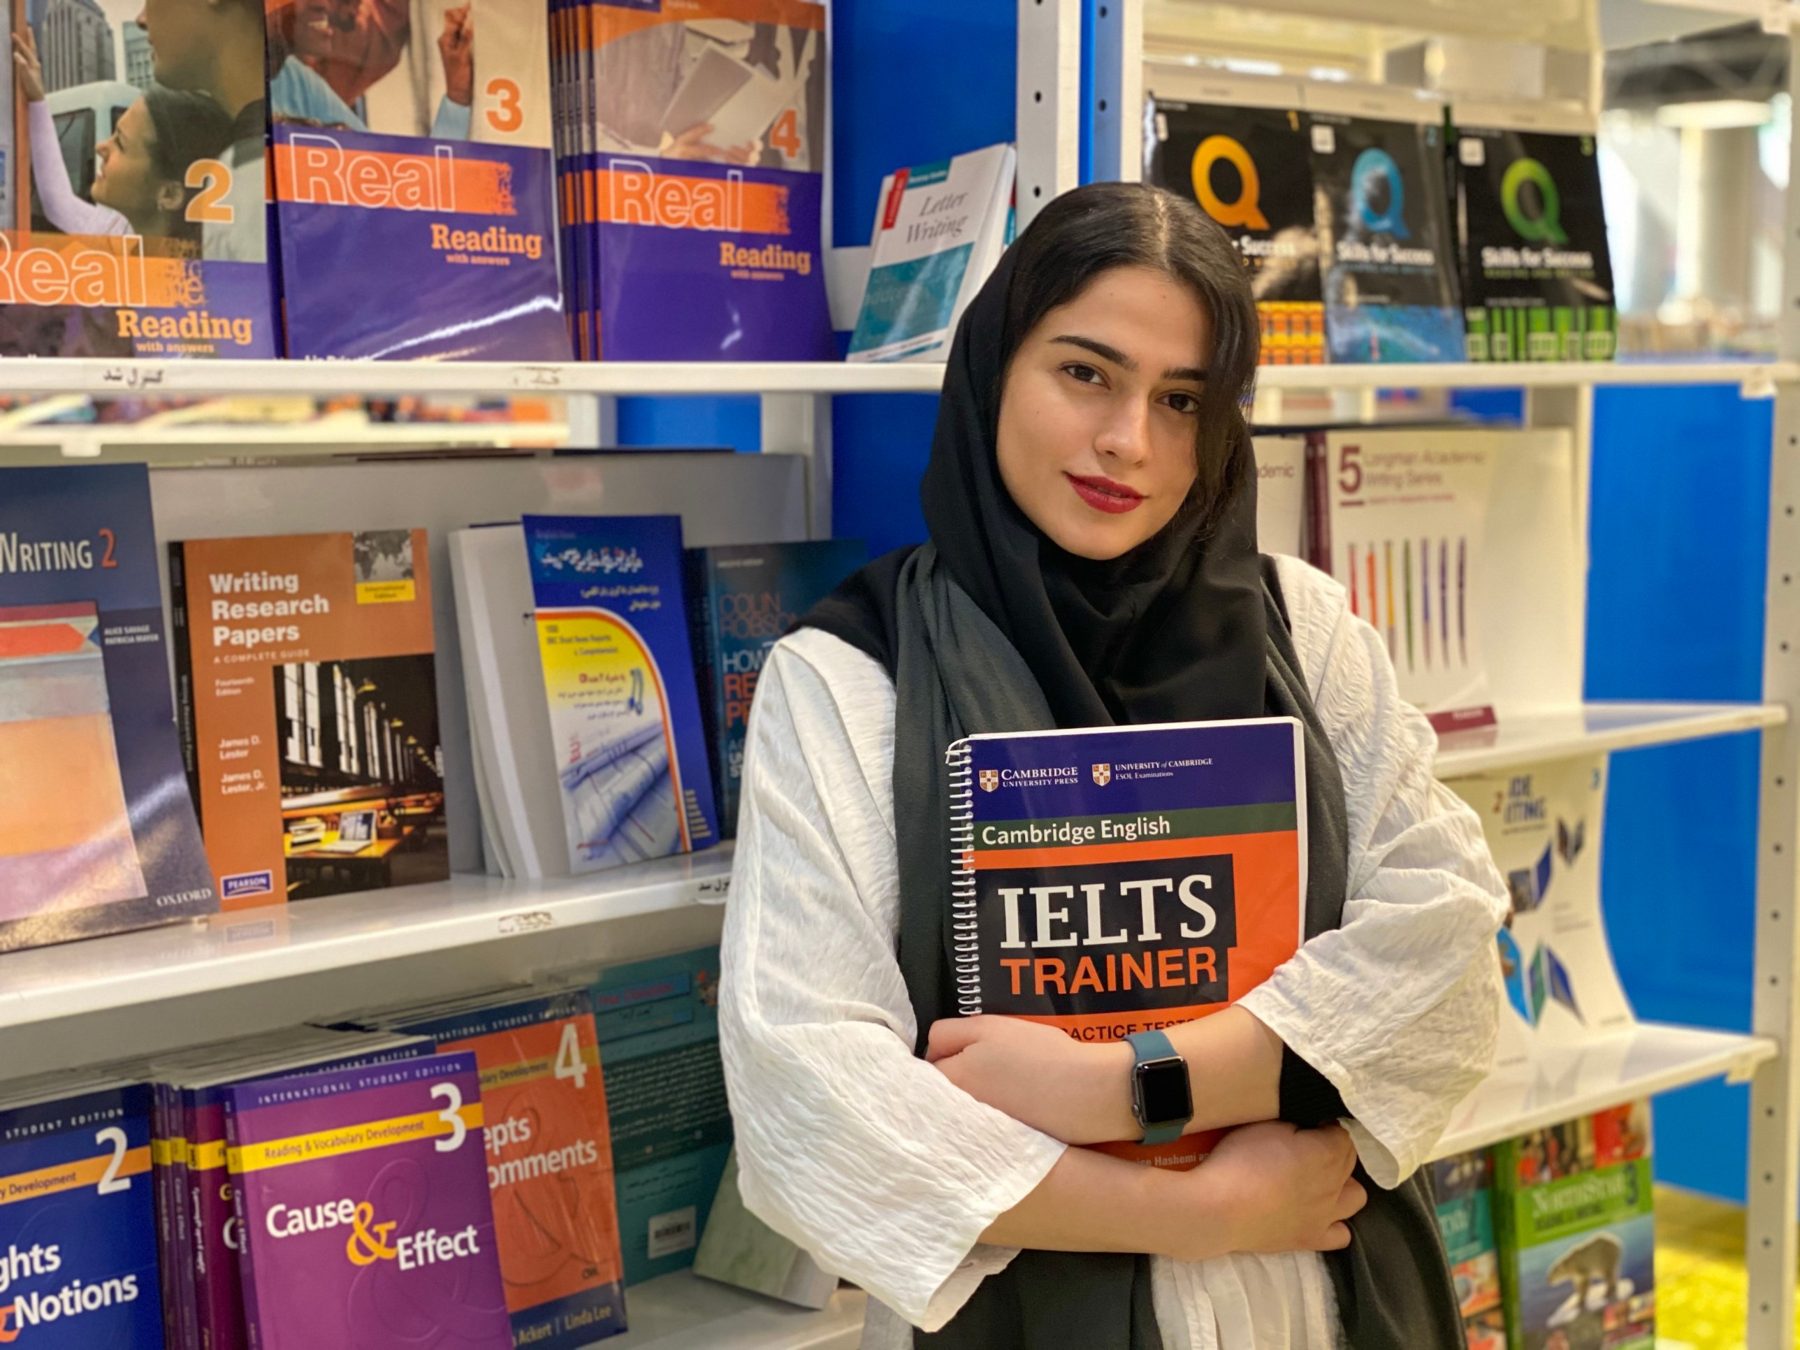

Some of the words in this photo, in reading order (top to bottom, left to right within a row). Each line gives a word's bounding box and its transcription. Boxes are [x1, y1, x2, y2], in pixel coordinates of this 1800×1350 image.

[485, 78, 523, 132] 3
[769, 108, 801, 159] 4
[290, 133, 455, 212] Real
[1191, 134, 1271, 231] Q
[185, 159, 234, 223] 2
[609, 159, 743, 231] Real
[919, 192, 969, 217] Letter
[1352, 147, 1411, 240] Q
[1502, 157, 1569, 243] Q
[430, 224, 542, 259] Reading
[906, 215, 968, 243] Writing
[719, 242, 811, 275] Reading
[116, 309, 252, 344] Reading
[1339, 444, 1362, 494] 5
[99, 528, 118, 568] 2
[209, 571, 299, 593] Writing
[211, 594, 330, 620] Research
[213, 626, 300, 648] Papers
[213, 656, 221, 664] A
[1001, 766, 1079, 780] CAMBRIDGE
[1115, 761, 1160, 771] UNIVERSITY
[1168, 757, 1214, 768] CAMBRIDGE
[1115, 771, 1133, 780] ESOL
[1135, 769, 1174, 779] Examinations
[1002, 779, 1052, 787] UNIVERSITY
[1054, 777, 1079, 785] PRESS
[982, 821, 1096, 846] Cambridge
[1101, 816, 1171, 842] English
[157, 889, 213, 908] OXFORD
[227, 876, 268, 891] PEARSON
[998, 874, 1217, 949] IELTS
[1000, 945, 1218, 995] TRAINER
[554, 1023, 588, 1089] 4
[257, 1083, 352, 1105] INTERNATIONAL
[359, 1070, 408, 1087] STUDENT
[415, 1062, 462, 1078] EDITION
[5, 1120, 62, 1140] STUDENT
[71, 1106, 125, 1126] EDITION
[366, 1120, 426, 1141] Development
[430, 1082, 467, 1153] 3
[95, 1126, 132, 1195] 2
[1154, 1152, 1197, 1166] Hashemi
[9, 1172, 76, 1195] Development
[266, 1197, 357, 1238] Cause
[346, 1201, 397, 1266] &
[397, 1224, 480, 1271] Effect
[13, 1273, 139, 1330] Notions
